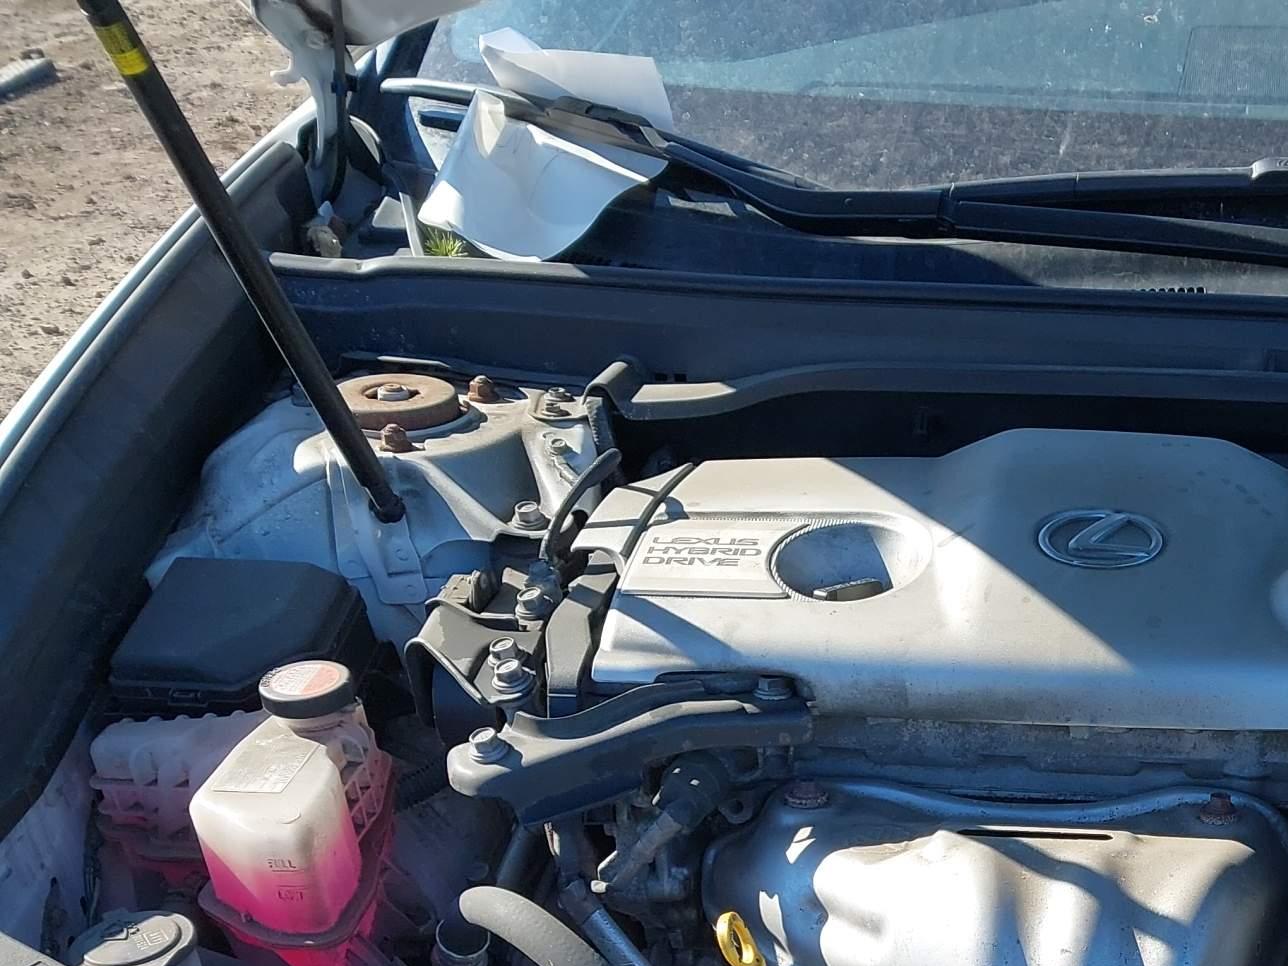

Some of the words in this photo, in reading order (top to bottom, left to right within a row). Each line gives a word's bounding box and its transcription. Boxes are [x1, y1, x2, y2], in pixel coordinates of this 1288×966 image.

[653, 537, 759, 546] LEXUS
[647, 546, 762, 556] HYBRID
[642, 556, 740, 566] DRIVE
